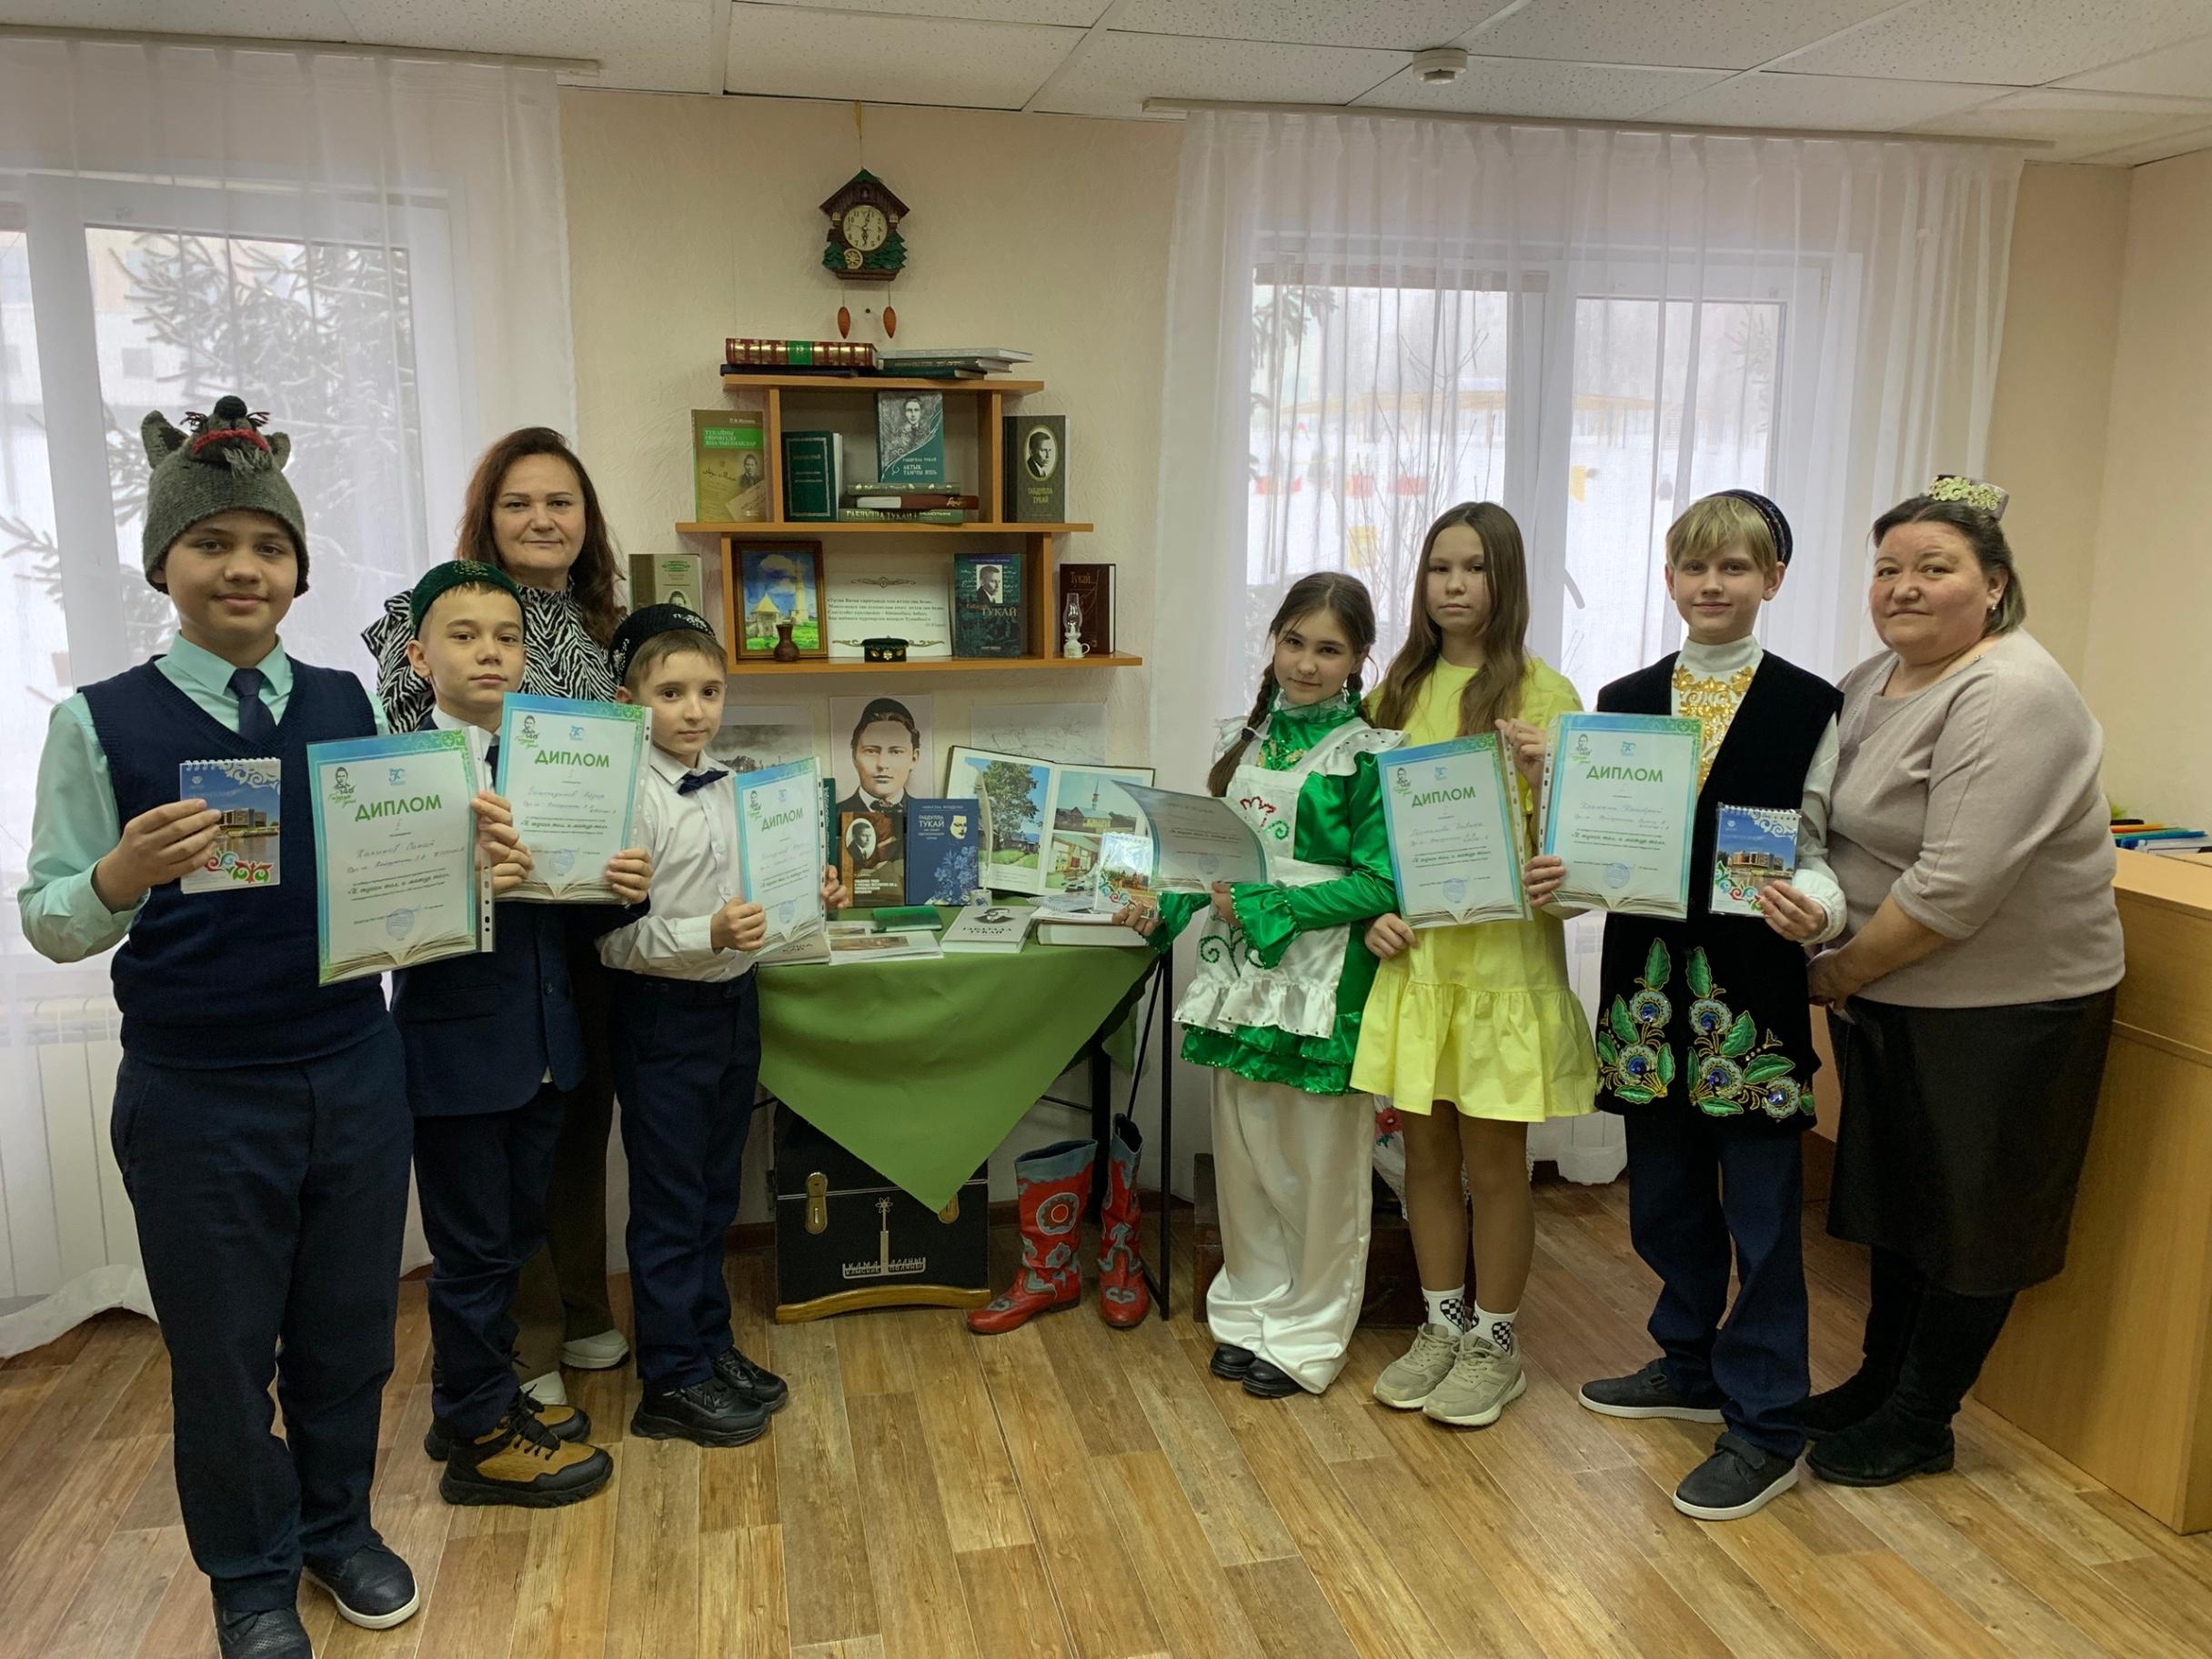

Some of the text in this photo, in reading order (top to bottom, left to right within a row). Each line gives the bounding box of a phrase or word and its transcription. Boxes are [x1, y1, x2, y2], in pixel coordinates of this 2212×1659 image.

[982, 607, 1018, 617] ТУКАЙ
[535, 749, 609, 768] ДИПЛОМ
[1586, 765, 1664, 783] ДИПЛОМ
[355, 794, 442, 822] ДИПЛОМ
[1412, 786, 1477, 809] ДИПЛОМ
[761, 807, 804, 833] ДИПЛОМ
